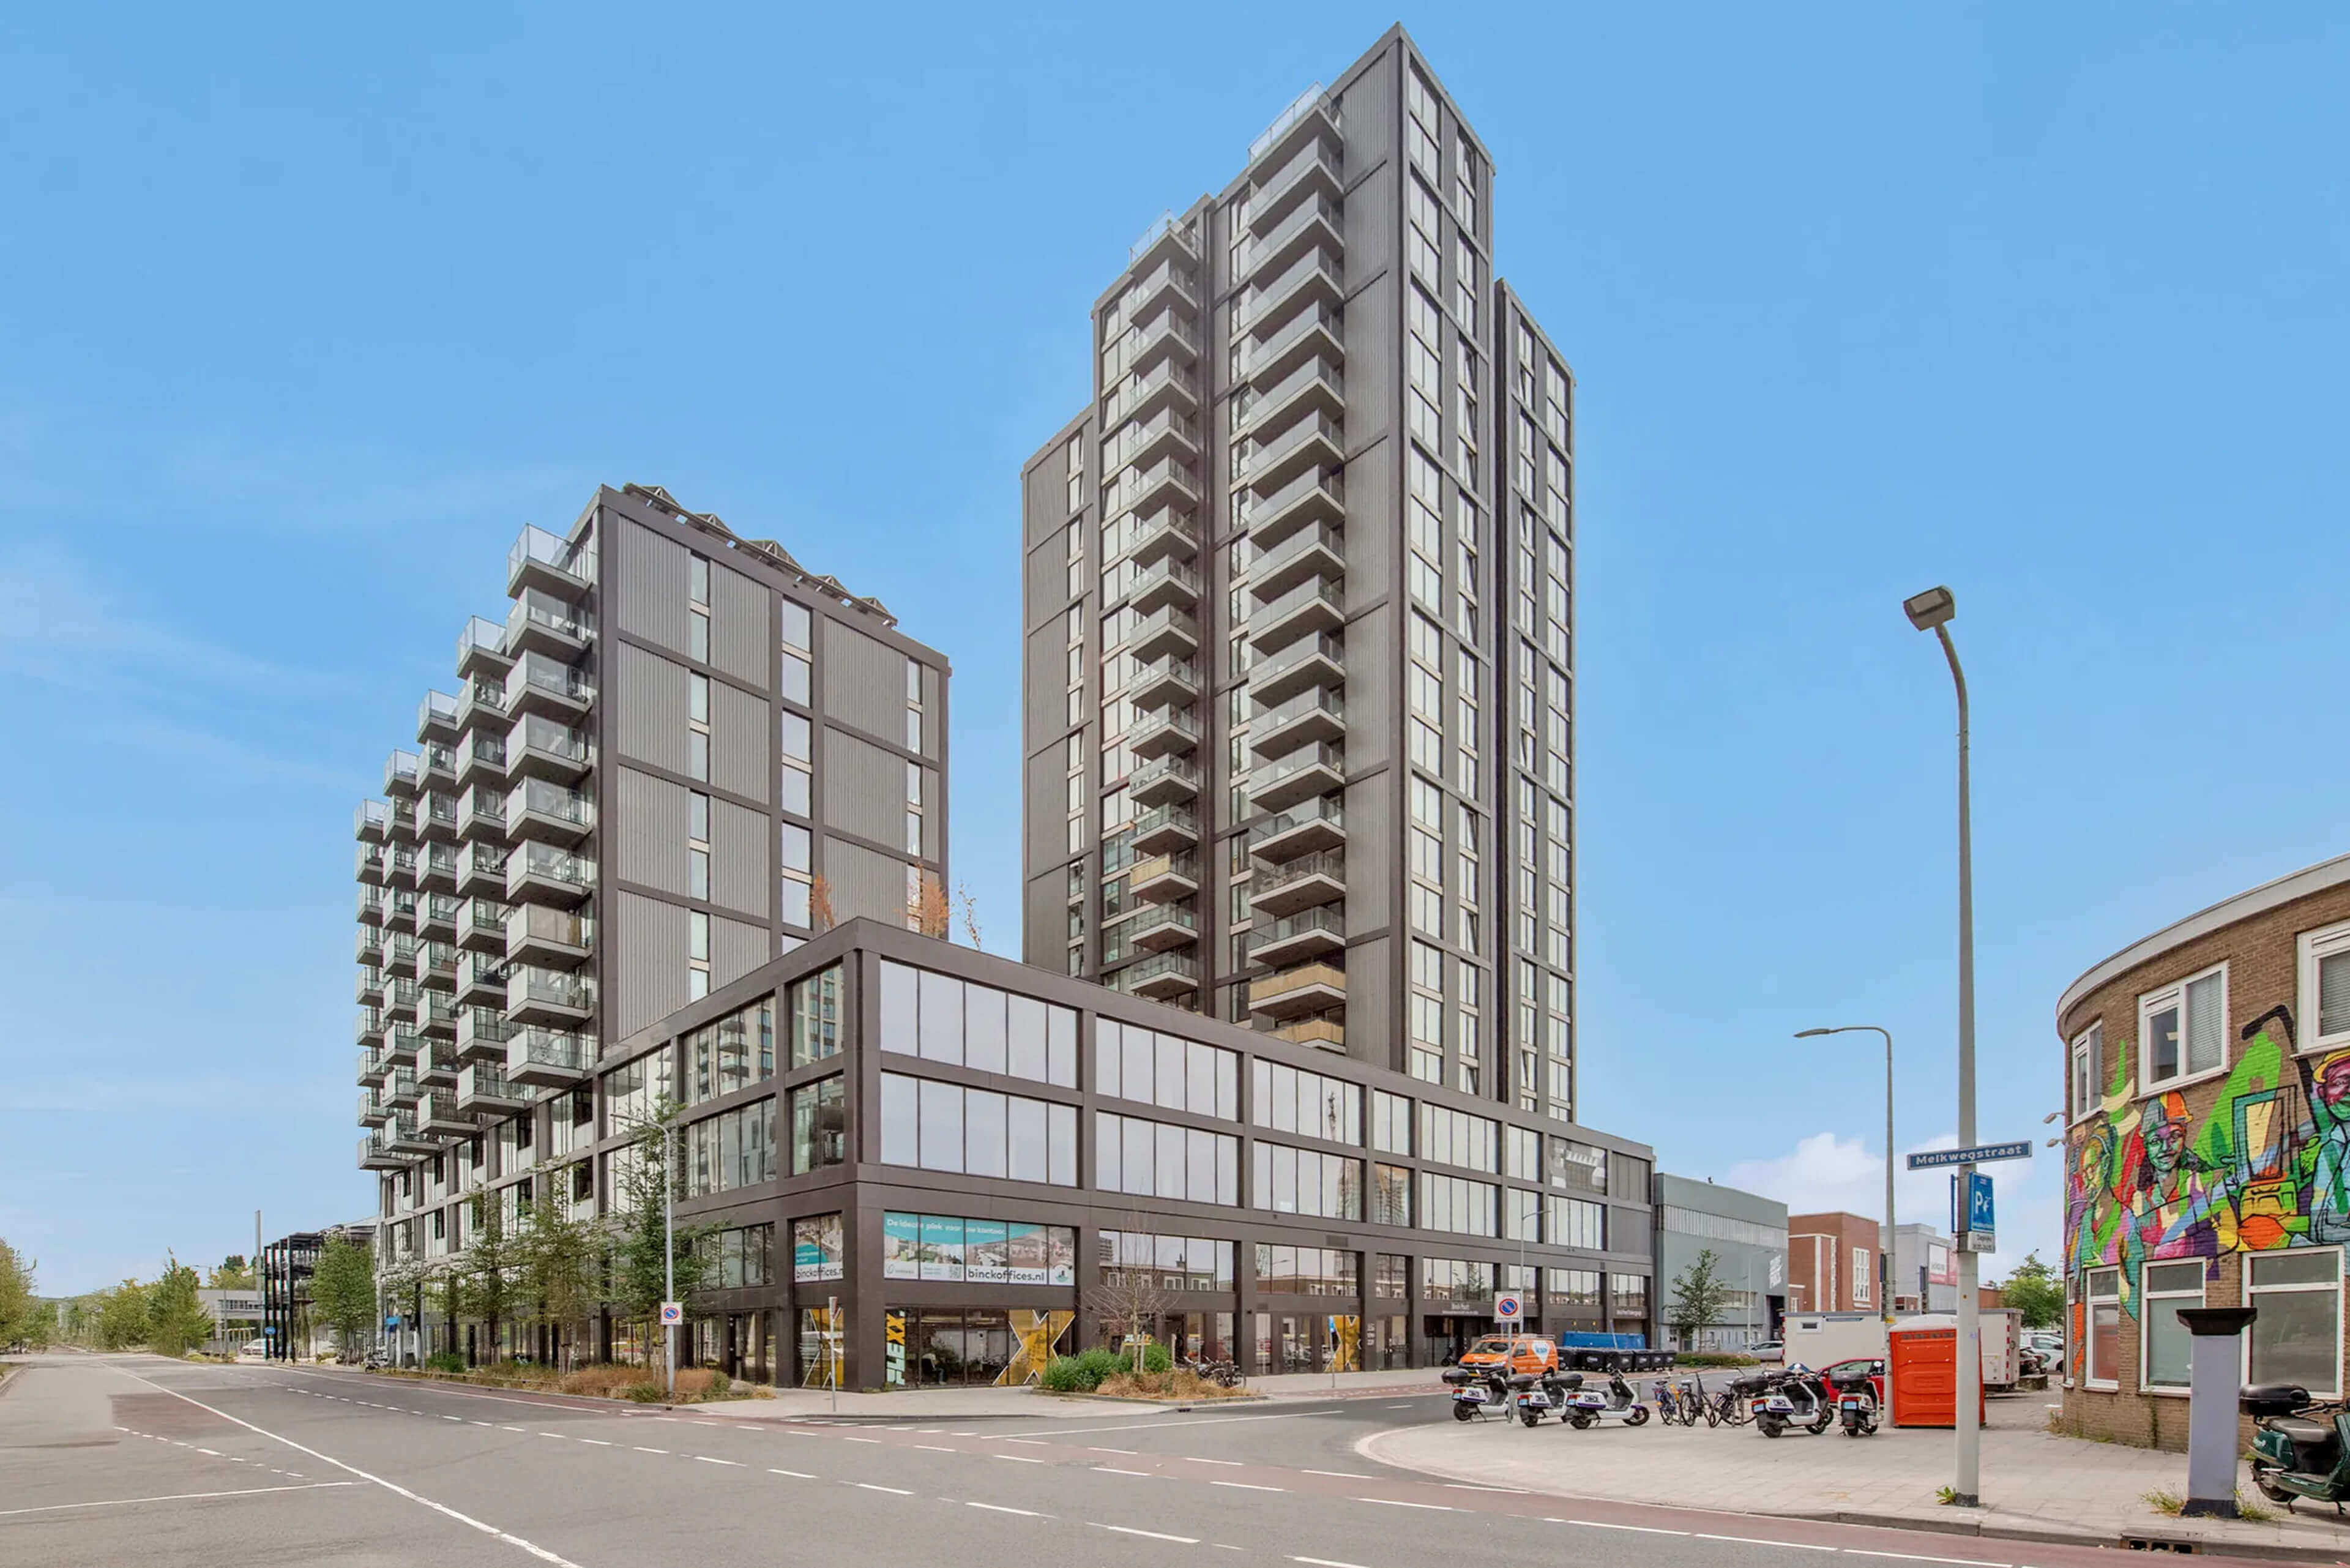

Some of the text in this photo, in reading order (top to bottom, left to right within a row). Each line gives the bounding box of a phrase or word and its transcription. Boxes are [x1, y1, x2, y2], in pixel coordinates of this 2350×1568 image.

[1915, 1145, 2023, 1165] Melkwegstraat
[898, 1220, 923, 1228] ideae
[968, 1268, 1045, 1281] binckoffices.nl
